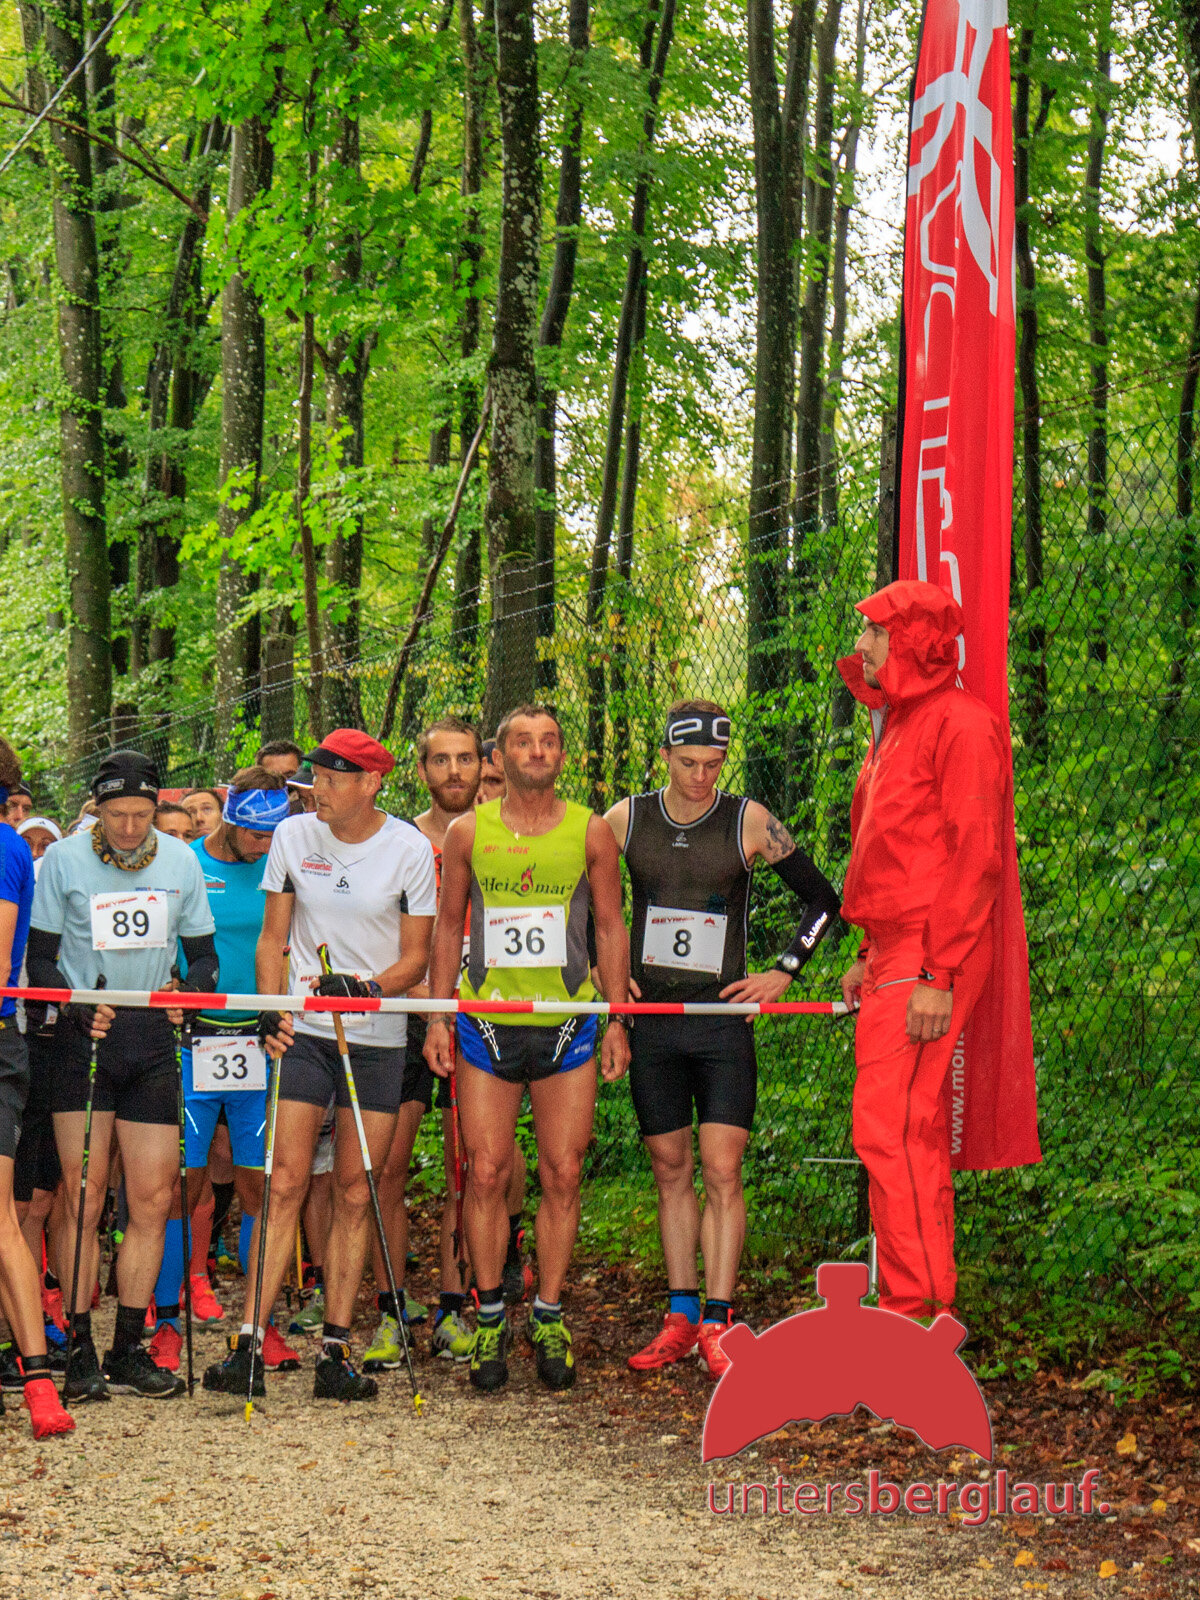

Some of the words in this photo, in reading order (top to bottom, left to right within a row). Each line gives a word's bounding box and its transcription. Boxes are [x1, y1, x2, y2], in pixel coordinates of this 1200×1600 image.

[112, 909, 150, 938] 89
[504, 926, 546, 956] 36
[672, 928, 692, 957] 8
[212, 1053, 249, 1080] 33
